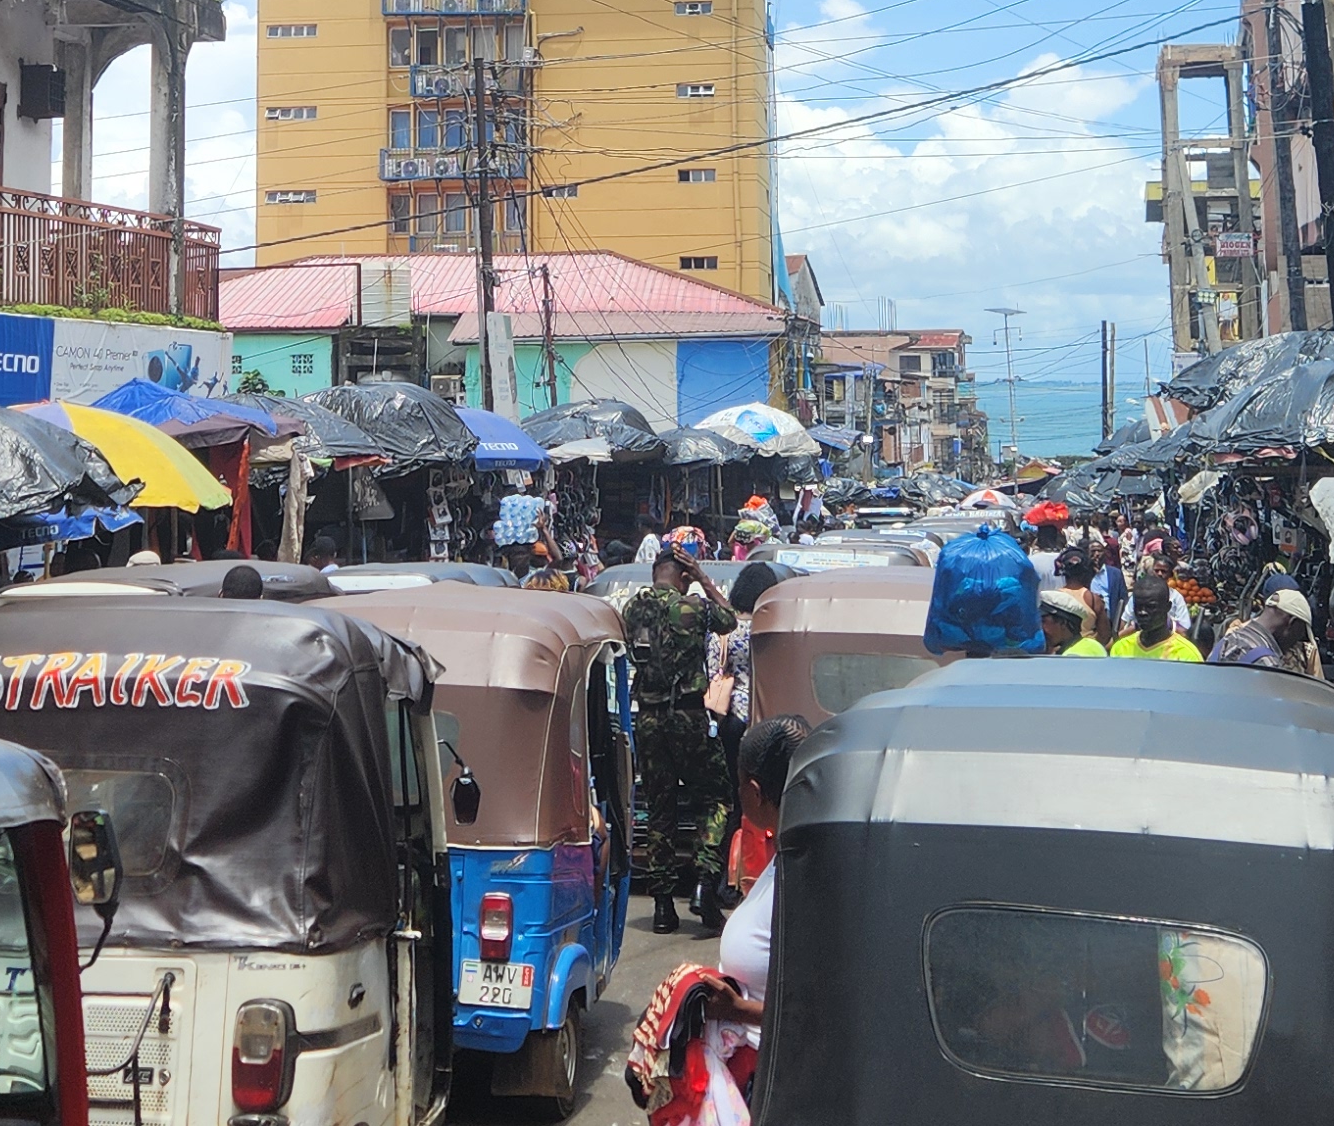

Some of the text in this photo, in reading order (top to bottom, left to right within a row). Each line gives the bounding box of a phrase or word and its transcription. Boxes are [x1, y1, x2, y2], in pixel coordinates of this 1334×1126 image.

[56, 345, 90, 359] CAMON
[106, 349, 131, 361] Premier
[104, 364, 124, 372] Anytime
[480, 442, 519, 451] TECNO
[22, 524, 59, 539] TECNO
[482, 964, 518, 985] AWV
[479, 986, 512, 1005] 220
